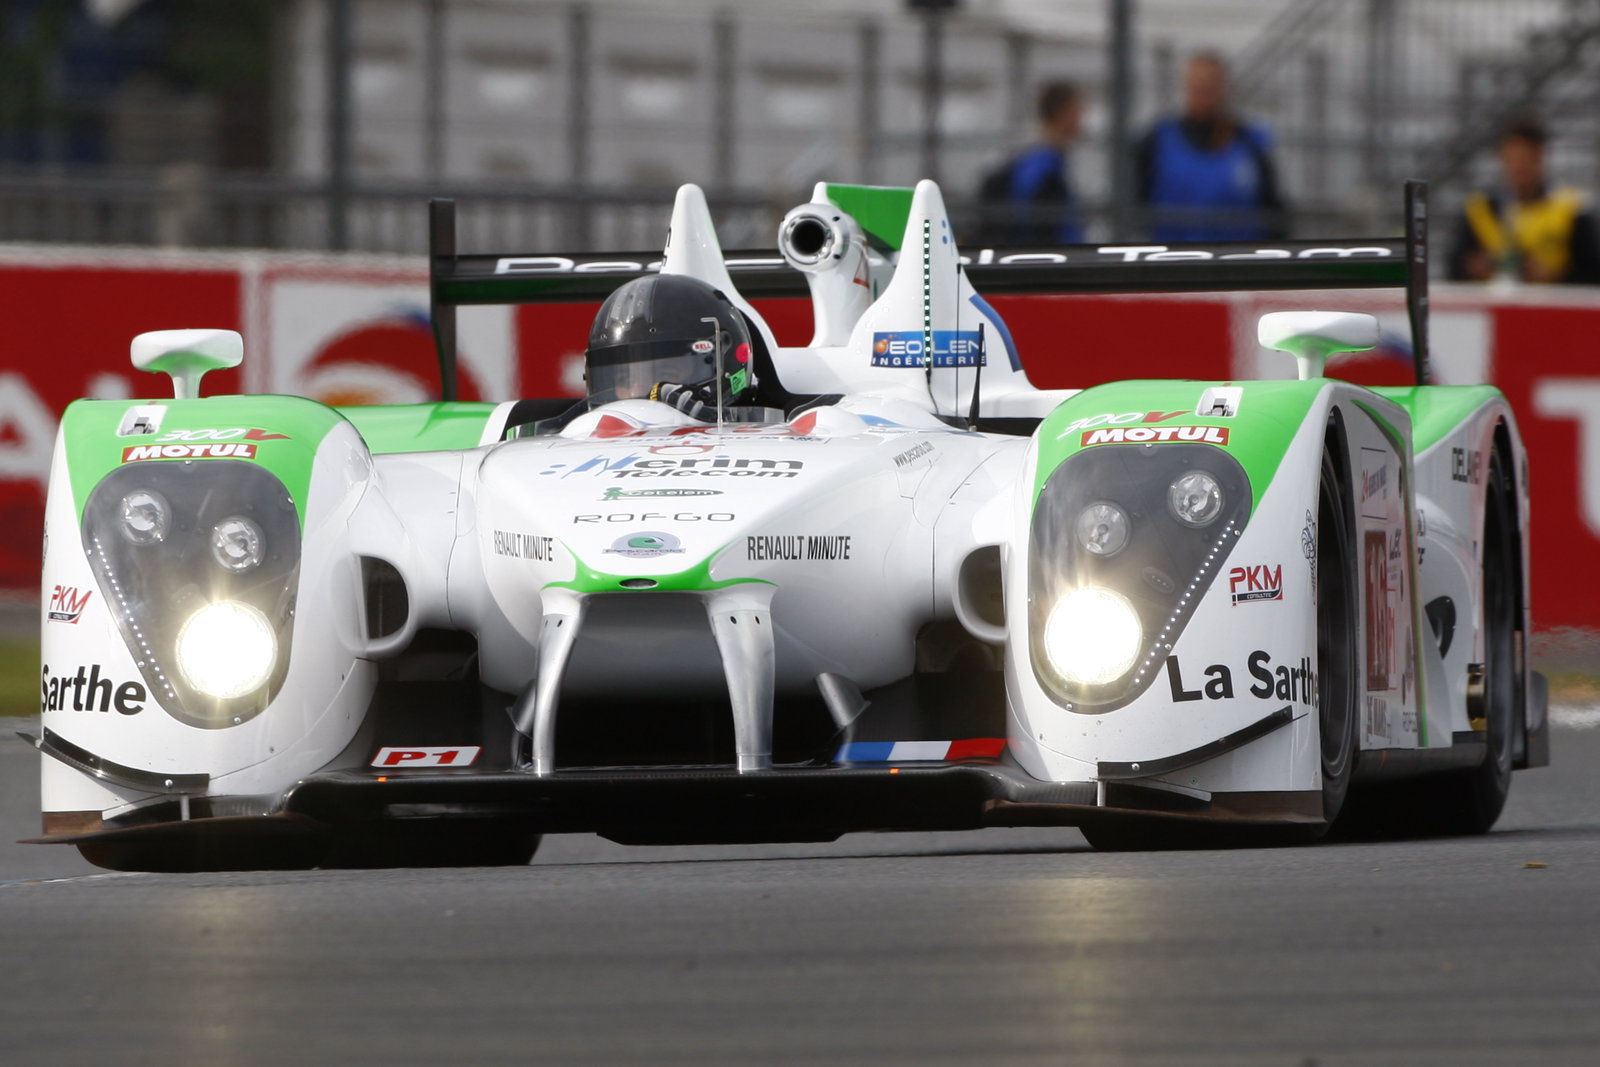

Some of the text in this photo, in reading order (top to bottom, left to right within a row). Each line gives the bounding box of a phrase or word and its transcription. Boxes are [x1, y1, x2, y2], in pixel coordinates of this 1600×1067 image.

[1097, 246, 1391, 262] Team
[694, 343, 712, 351] BELL
[154, 428, 292, 442] 300V
[1055, 410, 1193, 441] 300V
[1086, 426, 1225, 445] MOTUL
[126, 444, 252, 462] MOTUL
[561, 452, 804, 479] Nerim
[612, 468, 799, 479] Telecom
[574, 512, 736, 525] ROFGO
[494, 530, 553, 562] RENAULT MINUTE
[747, 536, 851, 561] RENAULT MINUTE
[1230, 564, 1282, 594] PKM
[49, 585, 93, 613] PKM
[1166, 654, 1234, 703] La
[42, 664, 147, 716] Sarthe
[382, 750, 460, 766] P1
